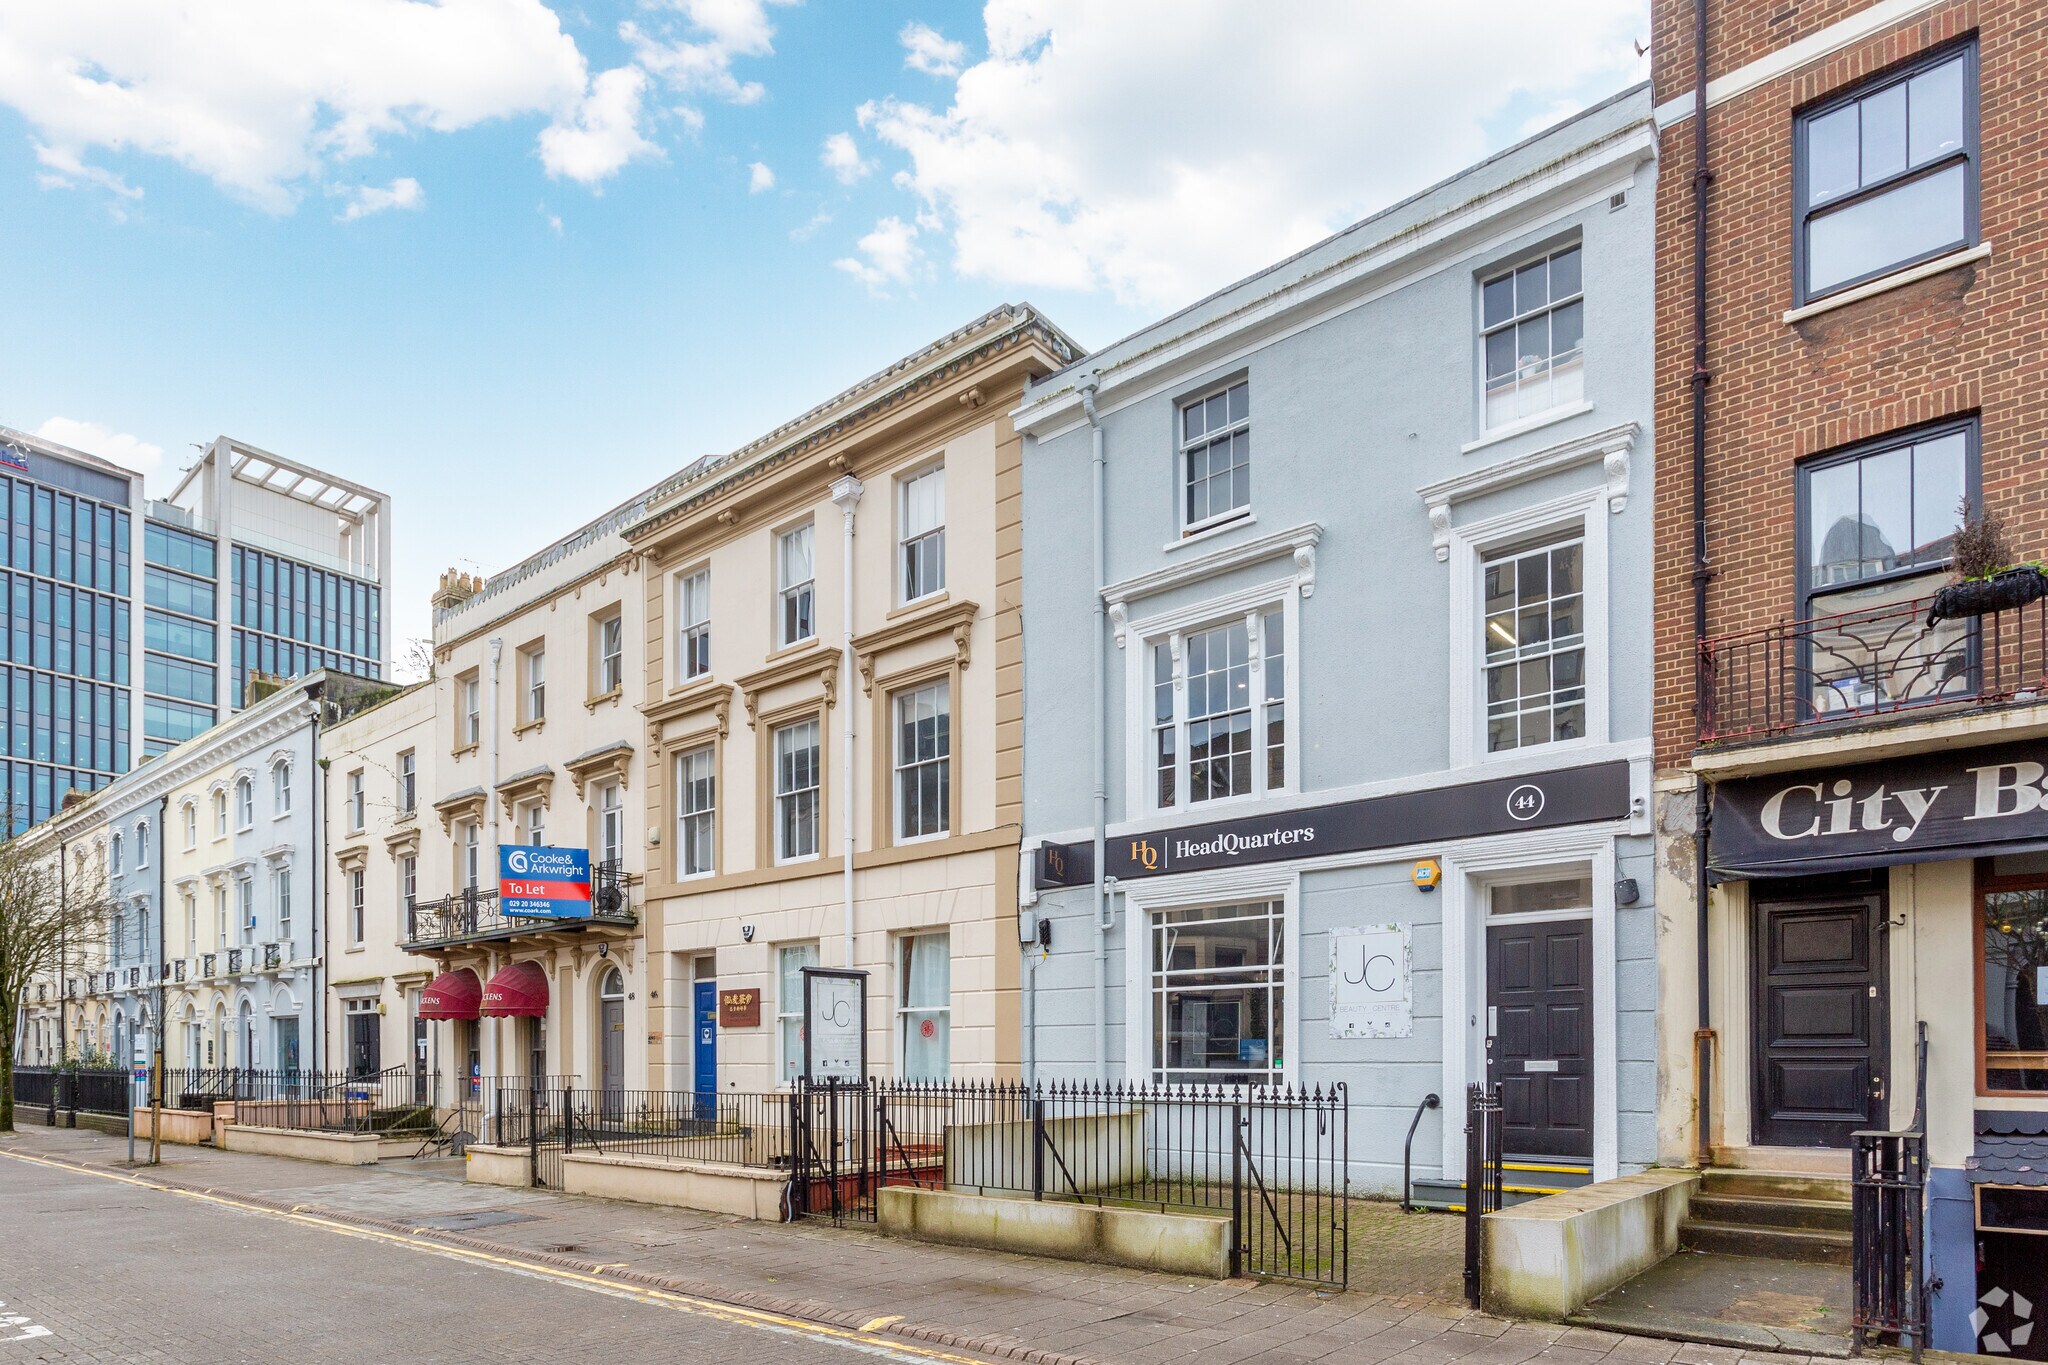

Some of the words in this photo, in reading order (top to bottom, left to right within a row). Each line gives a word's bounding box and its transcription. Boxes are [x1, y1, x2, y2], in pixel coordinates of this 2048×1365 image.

[1515, 795, 1535, 809] 44
[1760, 780, 1948, 842] City
[1131, 840, 1158, 869] HQ
[1176, 828, 1315, 859] HeadQuarters
[530, 863, 584, 877] Arkwright
[508, 882, 523, 894] To
[526, 883, 545, 895] Let
[529, 900, 550, 908] 346346
[1343, 944, 1395, 992] JC
[628, 992, 635, 1000] 48
[650, 990, 658, 999] 46
[822, 991, 850, 1028] JC
[1372, 1004, 1400, 1012] CENTRE
